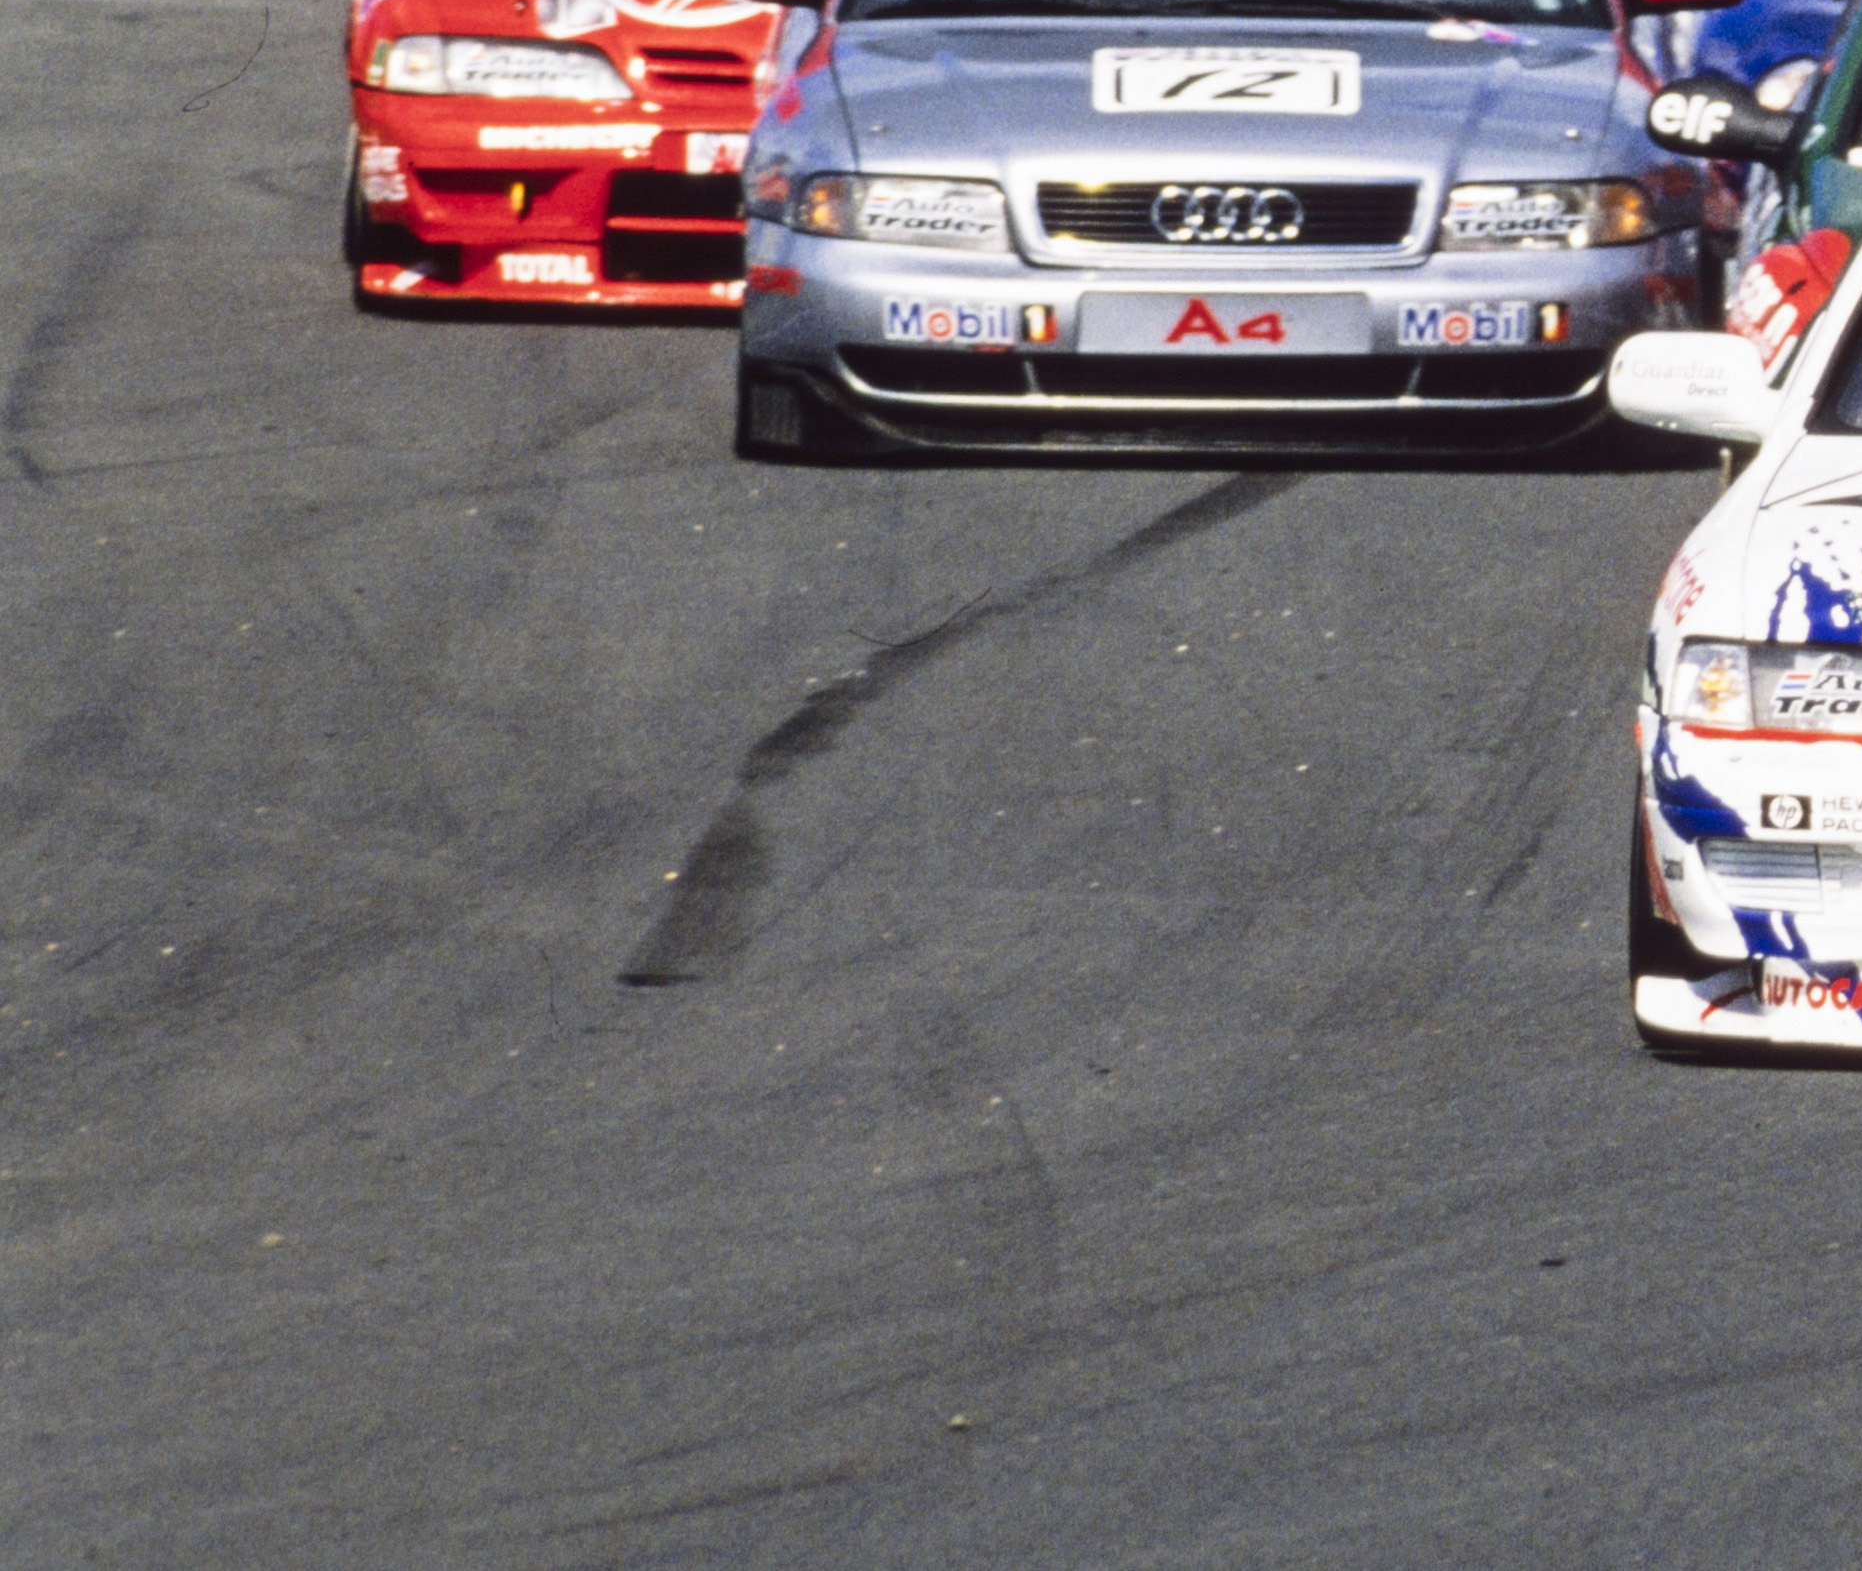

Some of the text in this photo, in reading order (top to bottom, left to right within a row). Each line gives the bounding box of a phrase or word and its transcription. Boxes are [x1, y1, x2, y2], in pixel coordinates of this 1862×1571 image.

[1162, 68, 1299, 99] 12
[1650, 89, 1730, 145] elf
[864, 214, 996, 235] Trader
[1449, 215, 1586, 234] Trader
[499, 254, 594, 285] TOTAL
[884, 302, 1042, 342] Mobil 1
[1164, 298, 1286, 344] A4
[1401, 305, 1557, 346] Mobil 1
